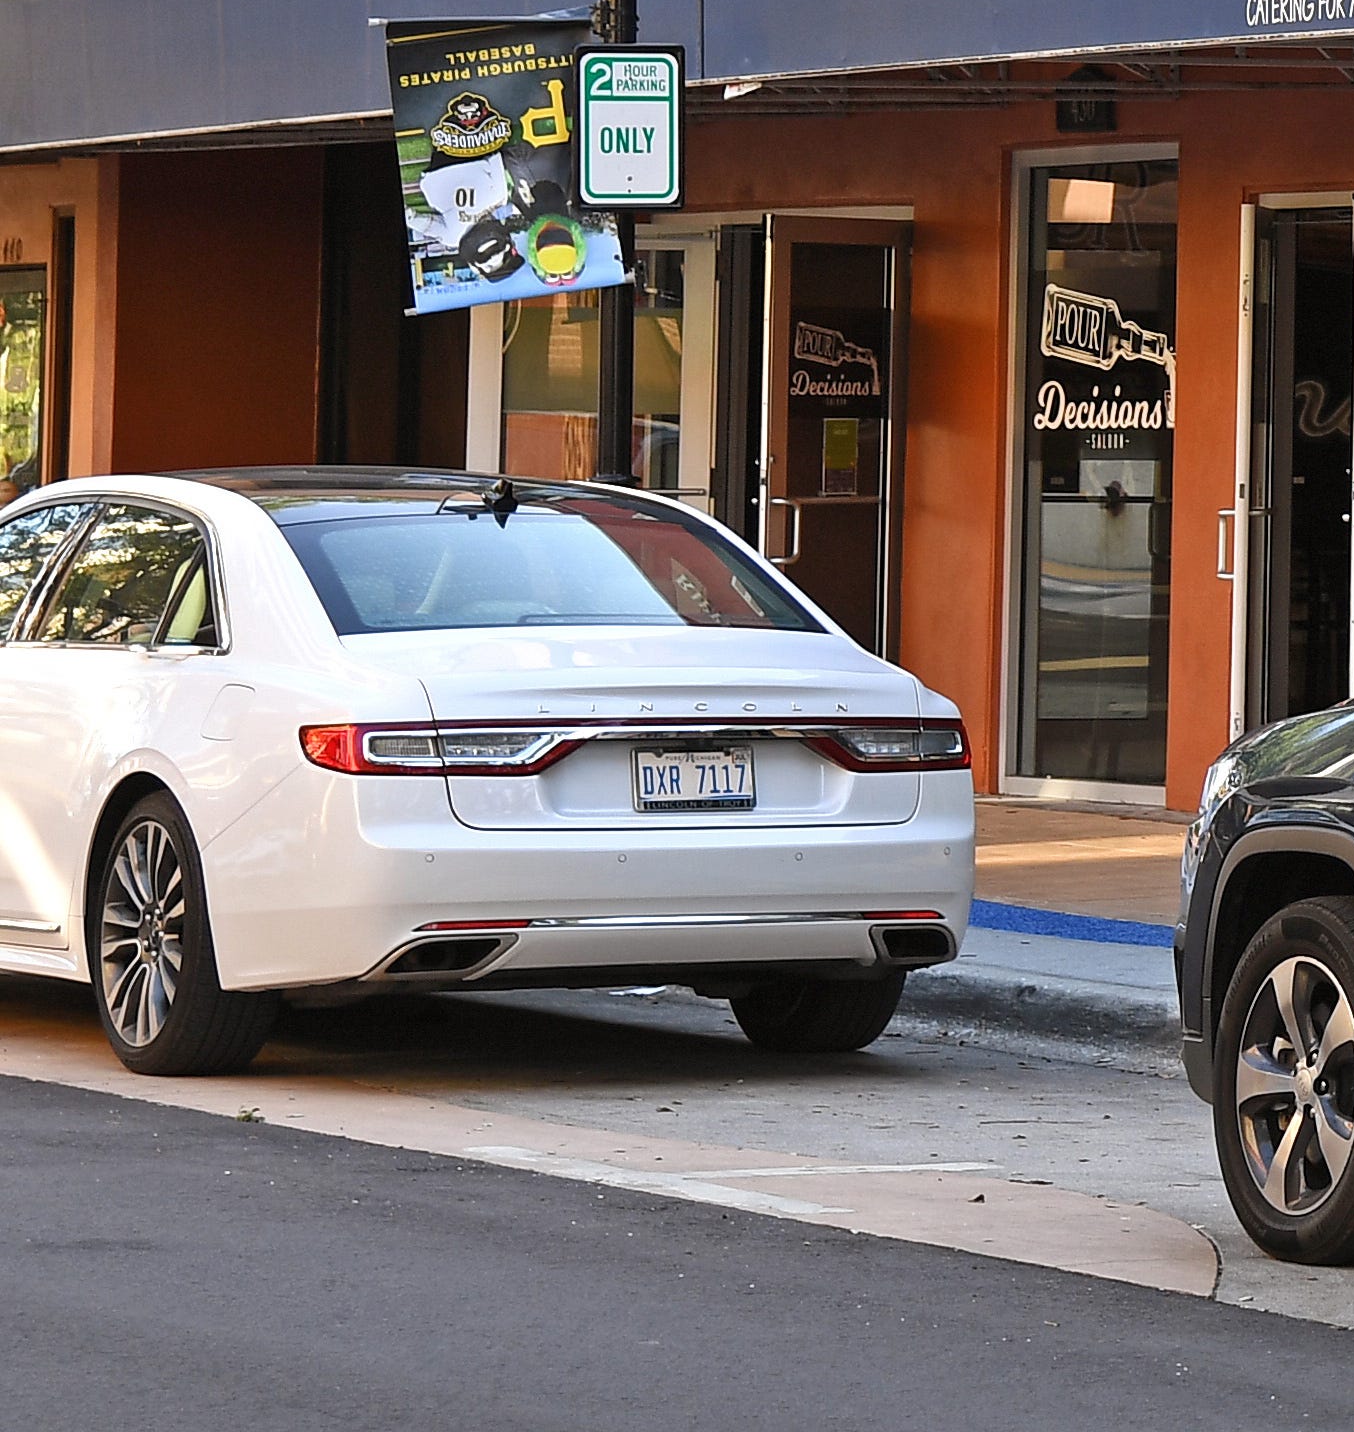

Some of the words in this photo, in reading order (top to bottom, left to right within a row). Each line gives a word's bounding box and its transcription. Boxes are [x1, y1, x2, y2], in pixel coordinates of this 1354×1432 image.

[444, 42, 536, 66] BASEBALL
[476, 53, 575, 78] ITTSBURGH
[398, 64, 472, 88] PIRATES
[589, 62, 612, 96] 2
[623, 64, 658, 78] HOUR
[616, 79, 667, 92] PARKING
[432, 120, 510, 148] MARAUDERS
[600, 126, 656, 154] ONLY
[454, 186, 477, 209] 10
[1054, 299, 1103, 352] POUR
[802, 329, 834, 359] POUR
[789, 369, 871, 397] Decisions
[1033, 379, 1164, 431] Decisions
[642, 765, 682, 796] DXR
[694, 763, 746, 795] 7117
